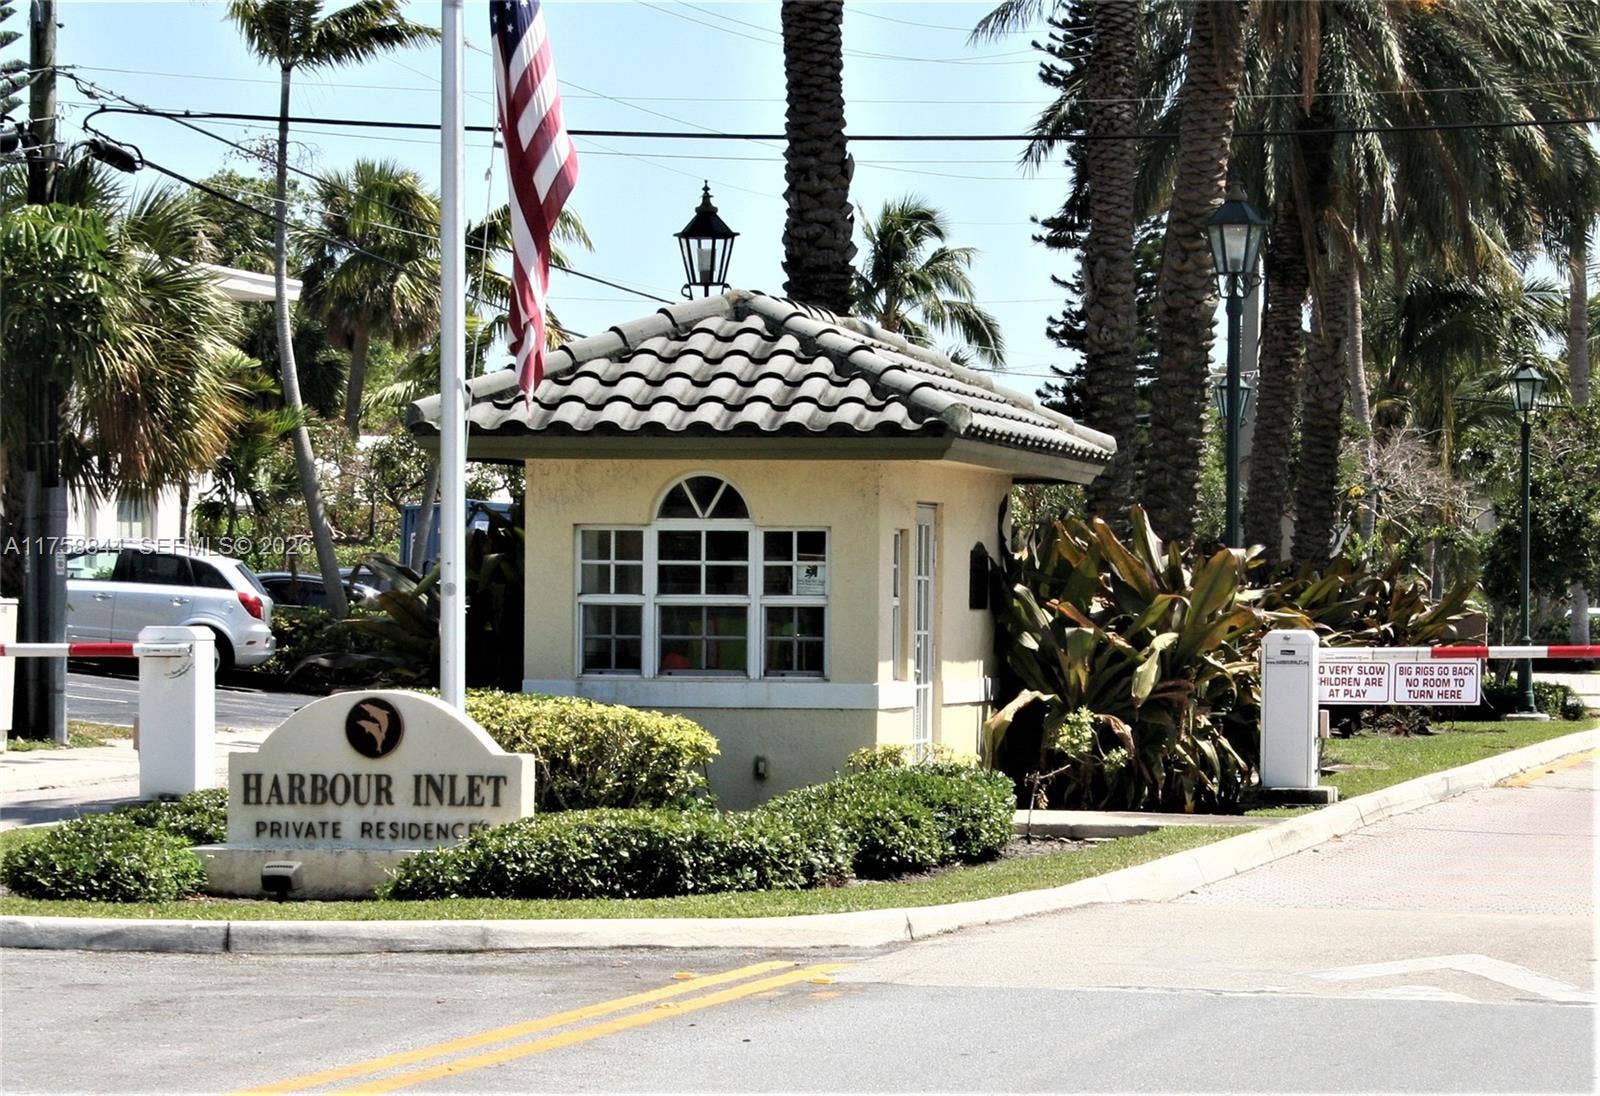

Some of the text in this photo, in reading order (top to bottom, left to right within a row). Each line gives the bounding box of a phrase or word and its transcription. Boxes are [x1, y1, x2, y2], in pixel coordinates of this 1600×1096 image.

[1318, 665, 1386, 676] O VERY SLOW
[1398, 666, 1475, 677] BIG RIGS GO BACK
[1318, 677, 1383, 687] HILDREN ARE
[1405, 678, 1465, 688] NO ROOM TO
[1328, 688, 1367, 698] AT PLAY
[1407, 689, 1462, 699] TURN HERE
[241, 773, 507, 808] HARBOUR INLET
[255, 821, 342, 840] PRIVATE
